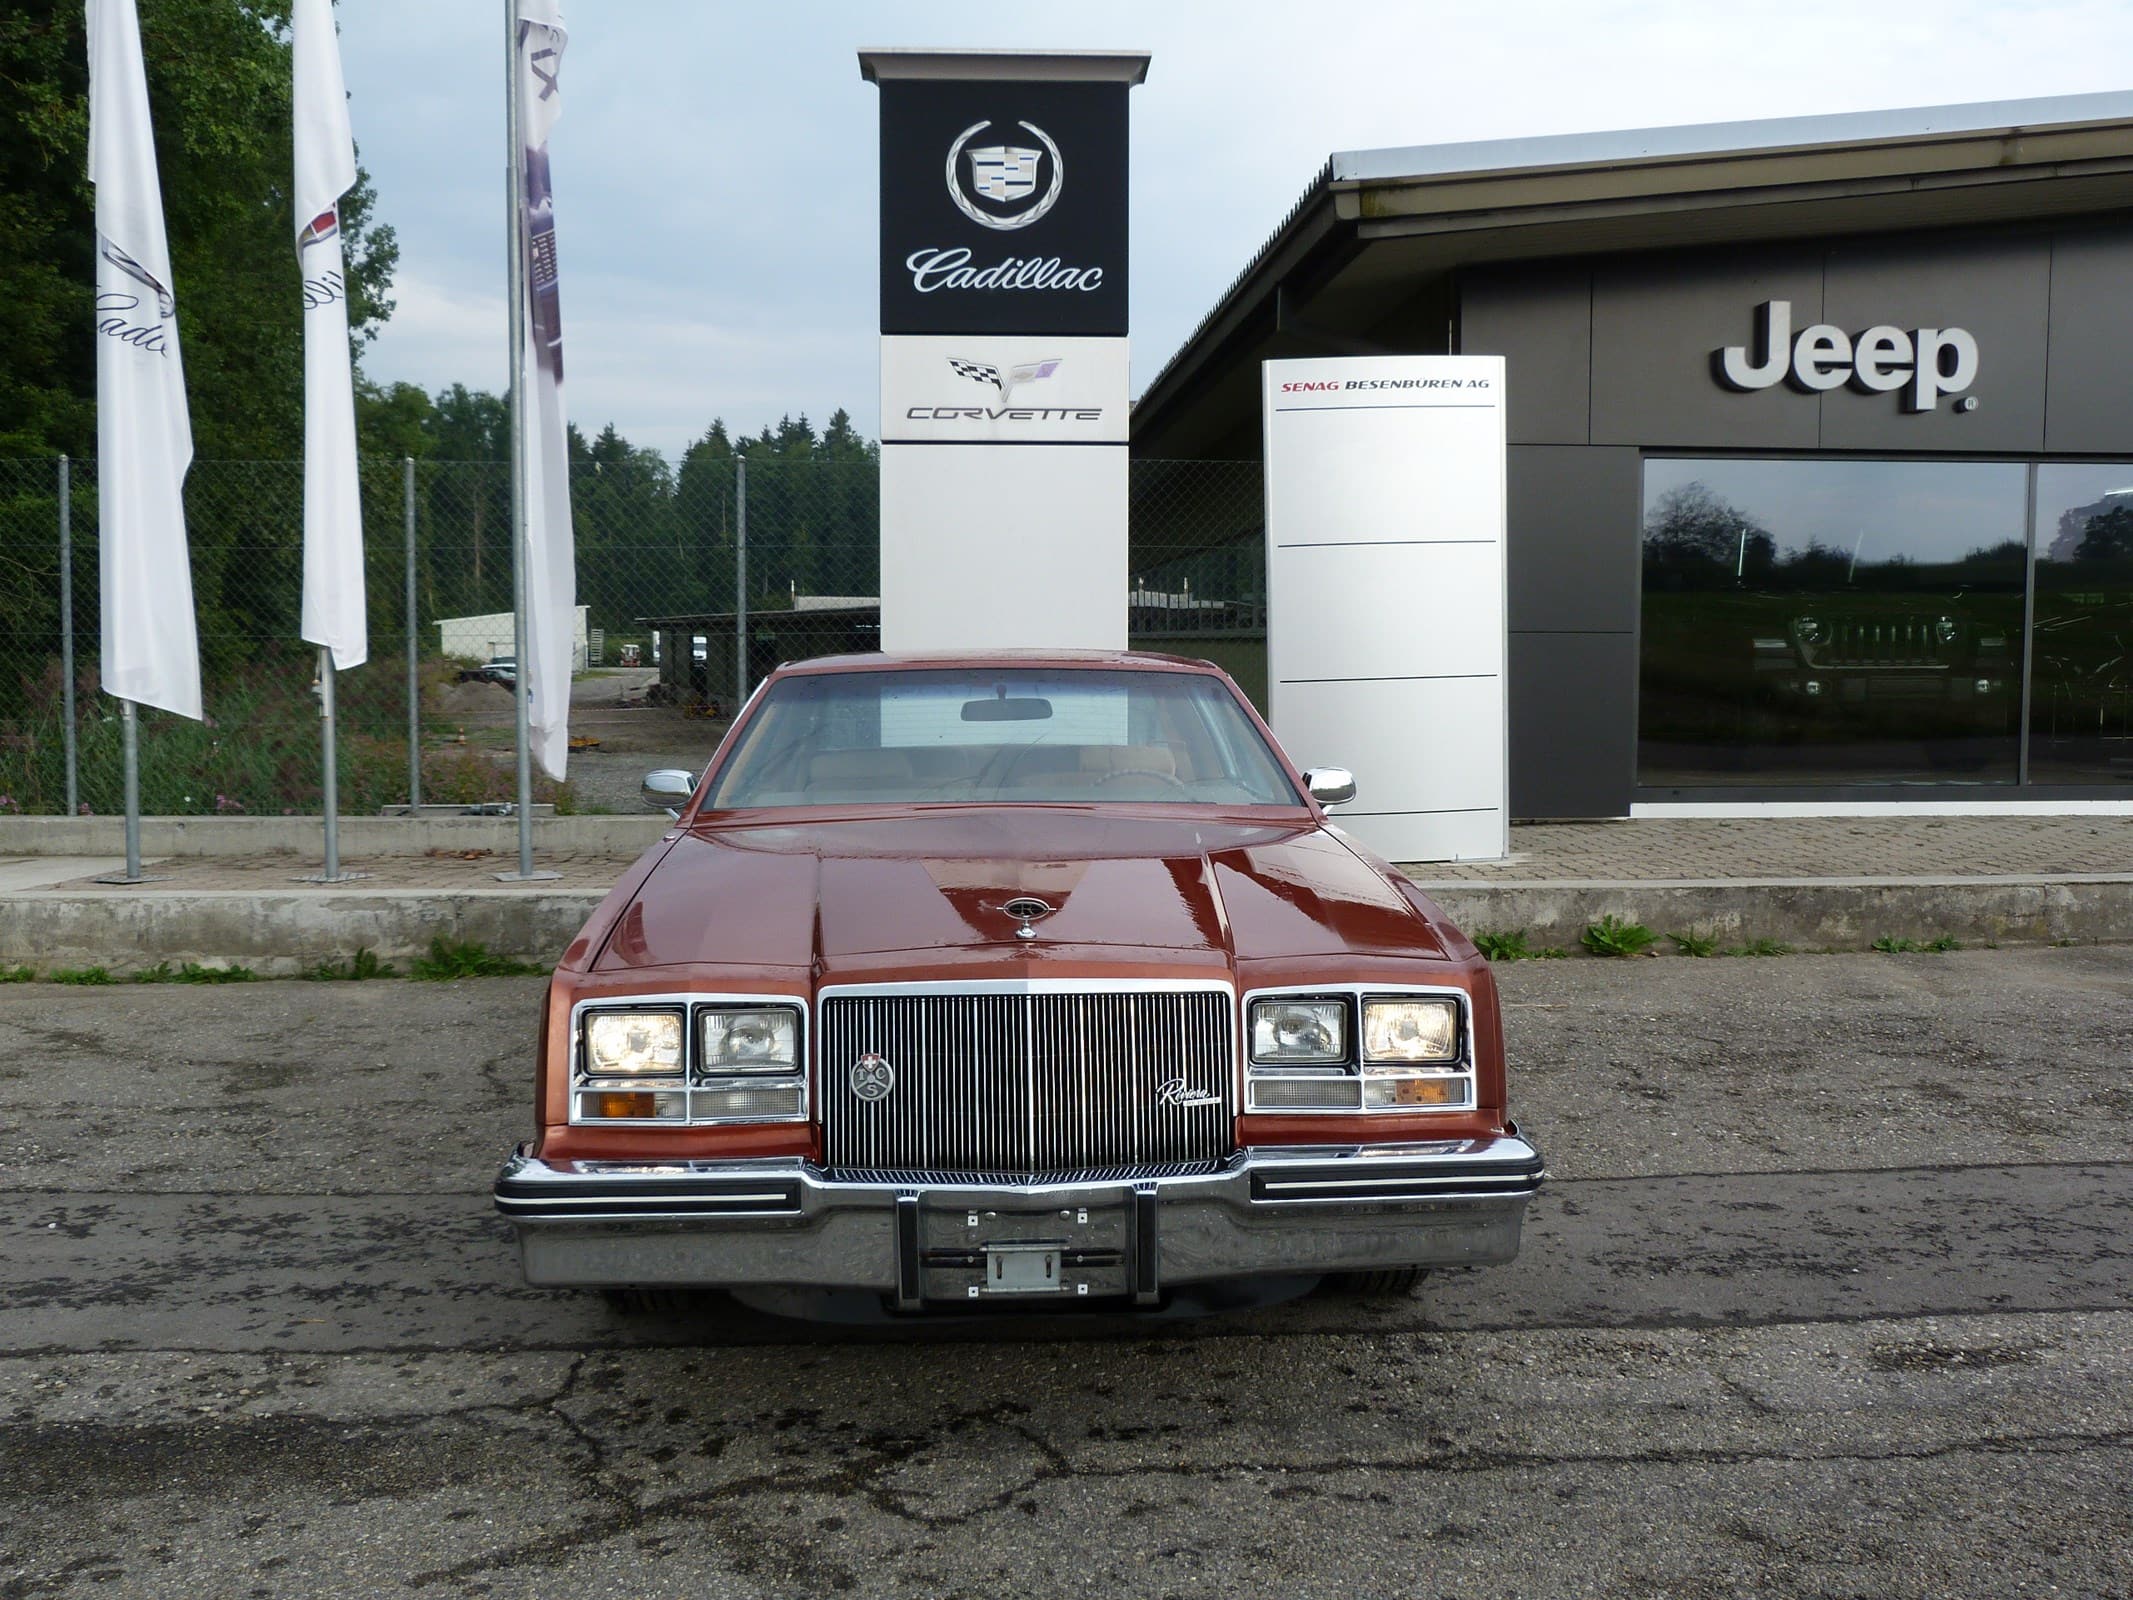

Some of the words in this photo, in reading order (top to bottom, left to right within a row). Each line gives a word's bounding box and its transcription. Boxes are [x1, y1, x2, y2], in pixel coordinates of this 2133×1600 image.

[906, 247, 1104, 293] Cadillac
[1723, 300, 1979, 410] Jeep
[1281, 380, 1340, 393] SENAG
[1344, 378, 1463, 390] BESENBÜREN
[1466, 379, 1490, 389] AG
[906, 407, 1103, 420] CORVETTE
